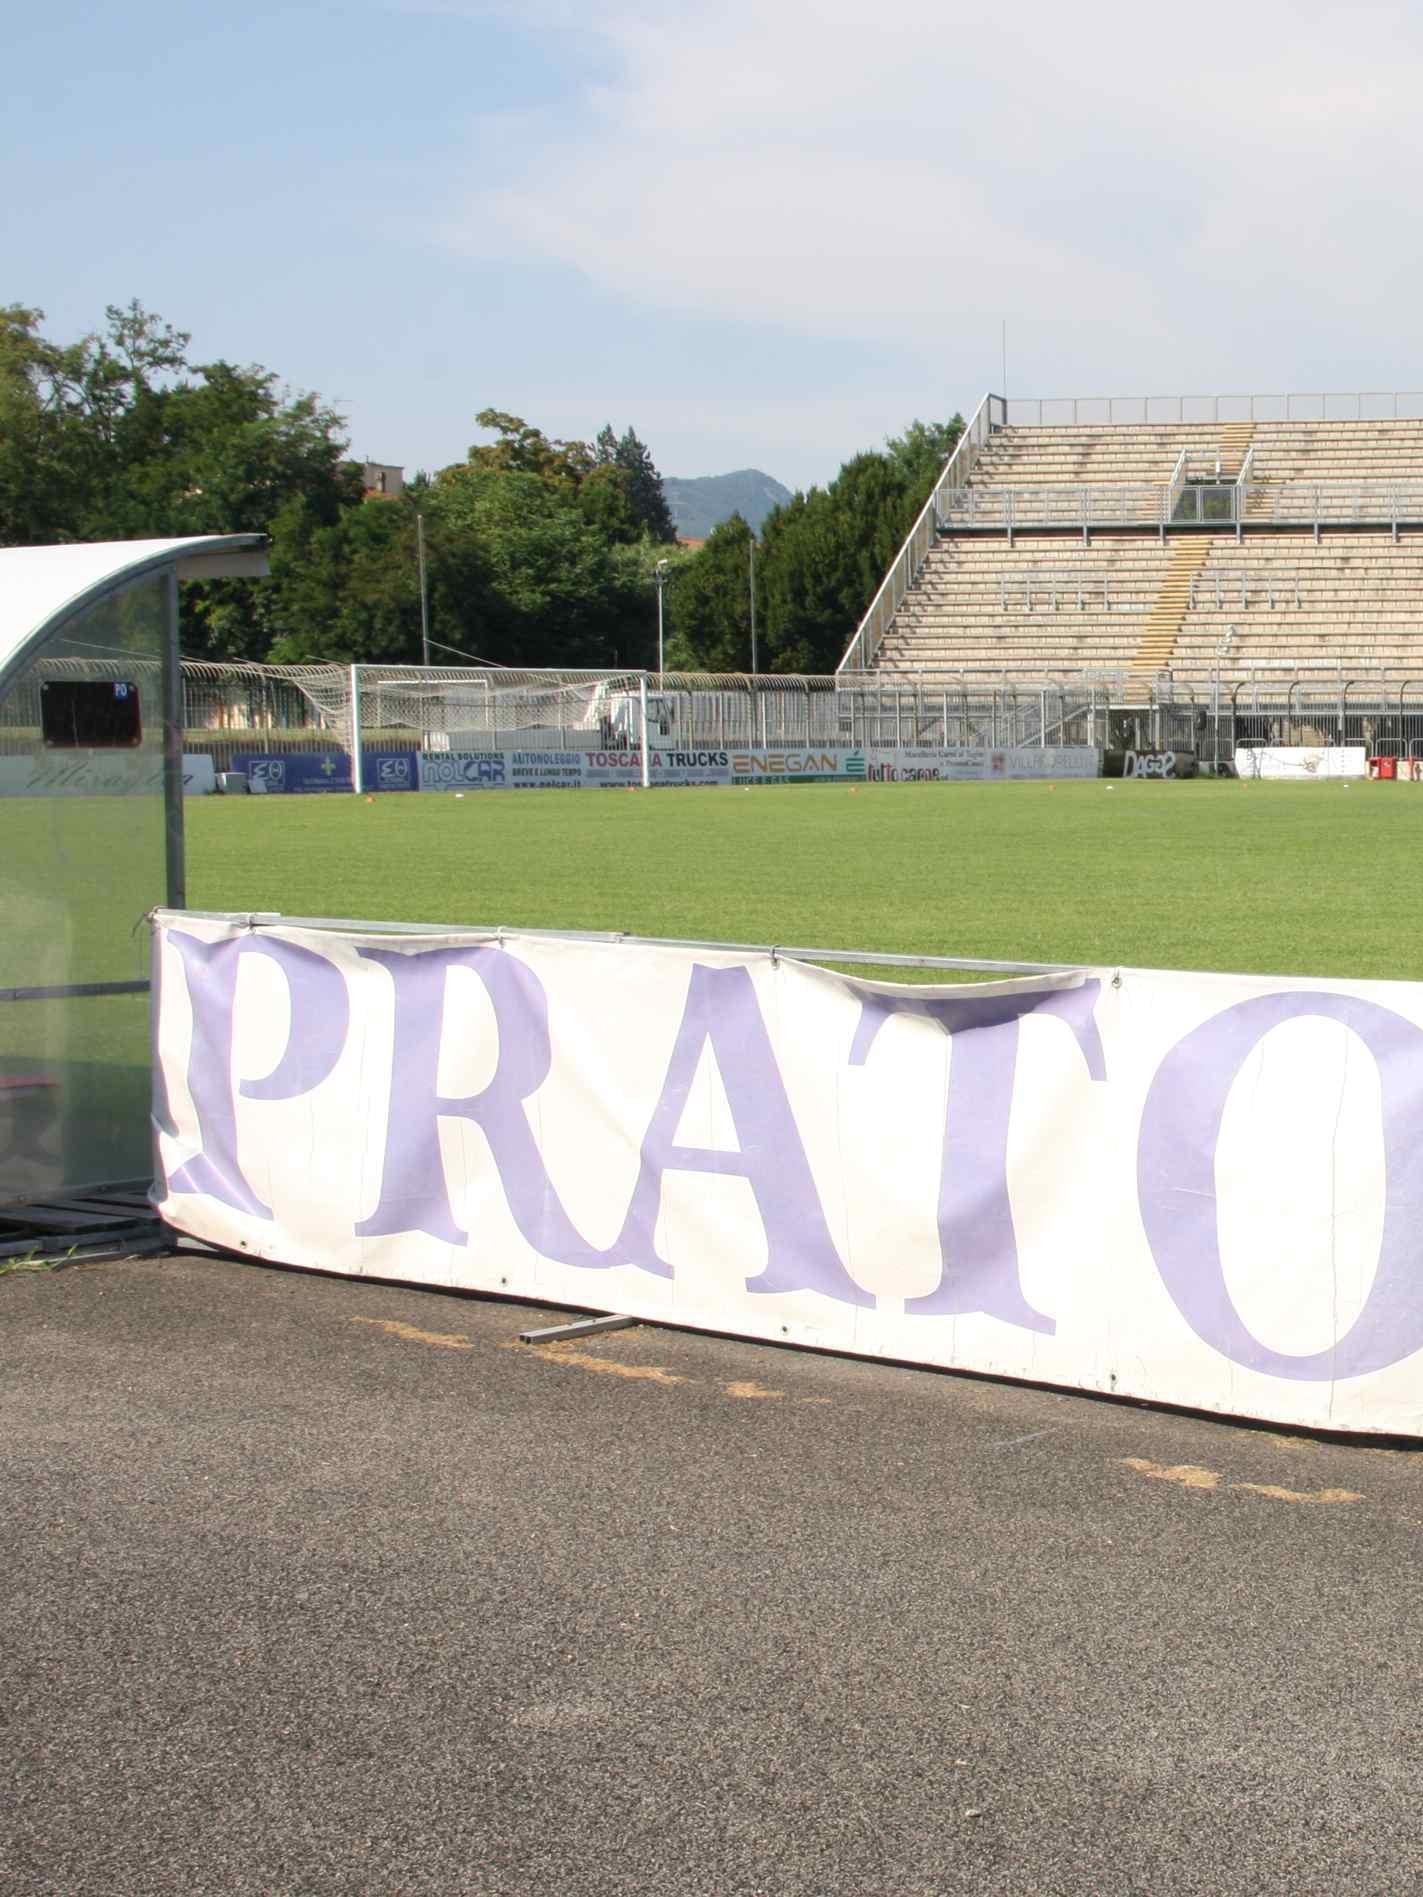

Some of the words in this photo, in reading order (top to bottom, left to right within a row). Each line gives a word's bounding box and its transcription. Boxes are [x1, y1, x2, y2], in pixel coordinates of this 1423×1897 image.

[458, 752, 505, 761] SOLUTIONS
[511, 752, 582, 765] AUTONOLEGGIO
[585, 751, 662, 767] TOSCAA
[667, 751, 729, 767] TRUCKS
[732, 753, 837, 773] ENEGAN
